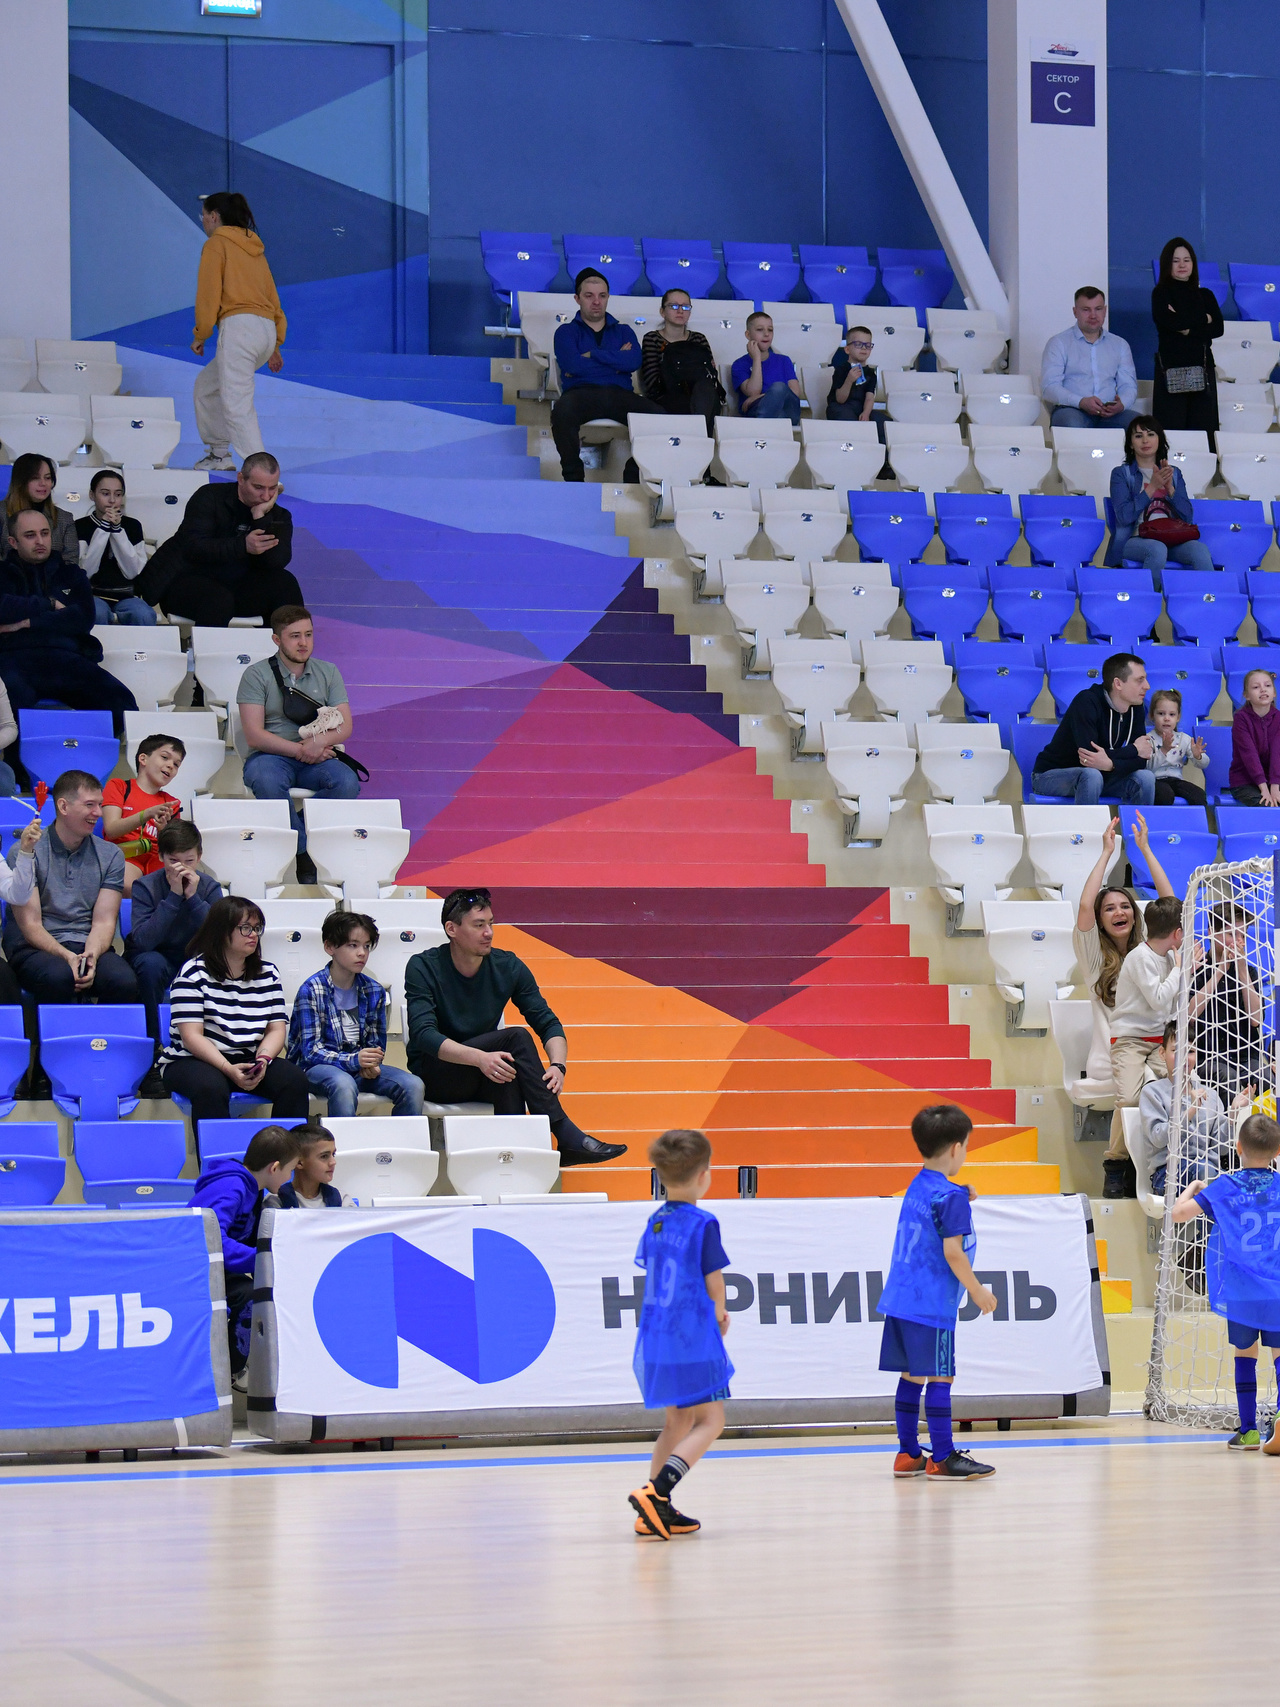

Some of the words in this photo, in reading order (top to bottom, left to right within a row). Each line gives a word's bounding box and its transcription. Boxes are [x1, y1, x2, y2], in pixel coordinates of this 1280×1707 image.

[1046, 74, 1080, 84] СЕКТОР
[893, 1220, 922, 1264] 17
[601, 1270, 1057, 1330] НРНИЛЬ
[644, 1256, 677, 1308] 19
[0, 1292, 173, 1354] ЕЛЬ
